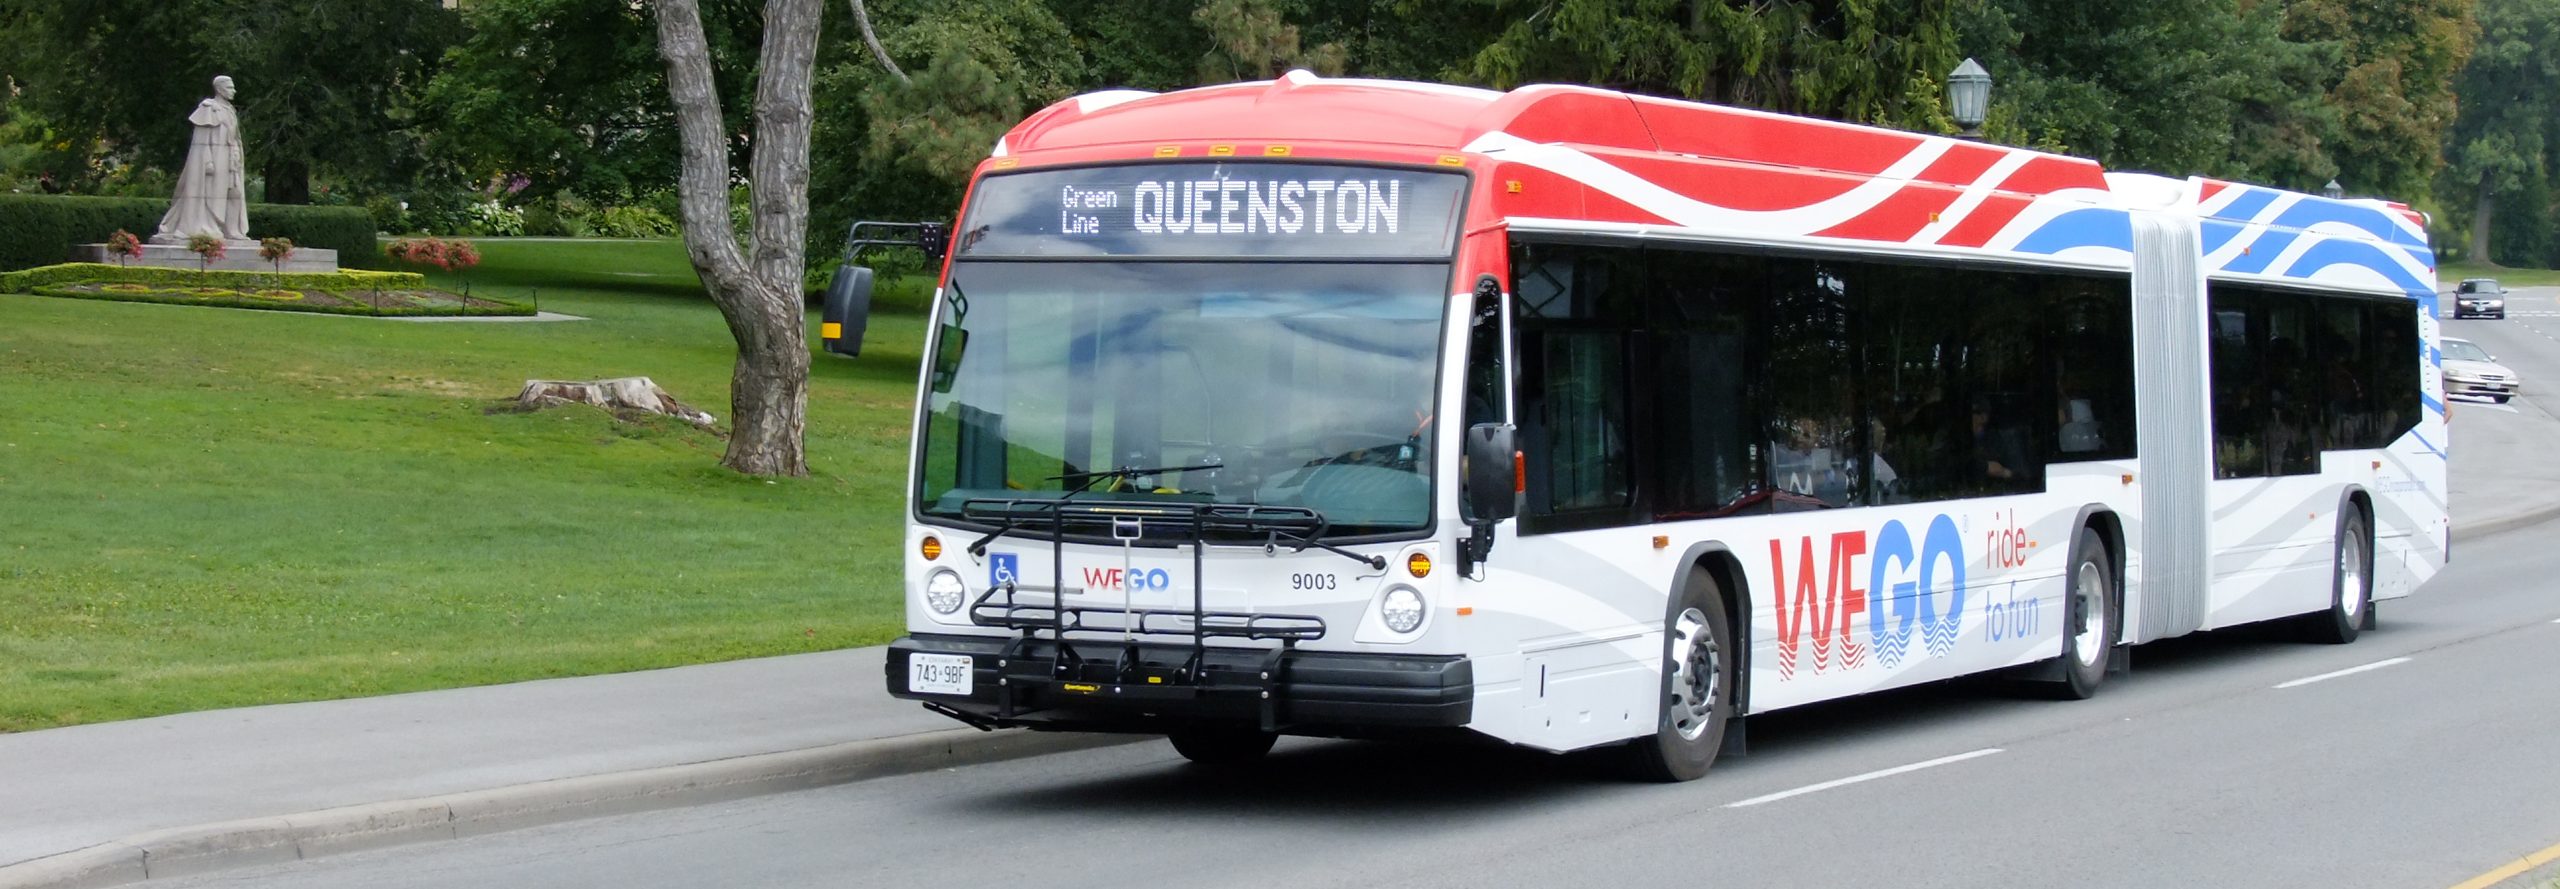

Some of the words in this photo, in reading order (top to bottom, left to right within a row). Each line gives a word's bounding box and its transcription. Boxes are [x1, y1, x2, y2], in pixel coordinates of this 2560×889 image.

[1063, 185, 1118, 208] Green
[1134, 180, 1400, 233] QUEENSTON
[1062, 210, 1100, 234] Line
[1083, 567, 1170, 592] WEGO
[1292, 573, 1337, 591] 9003
[1769, 513, 1966, 682] WEGO
[2008, 579, 2039, 639] fun
